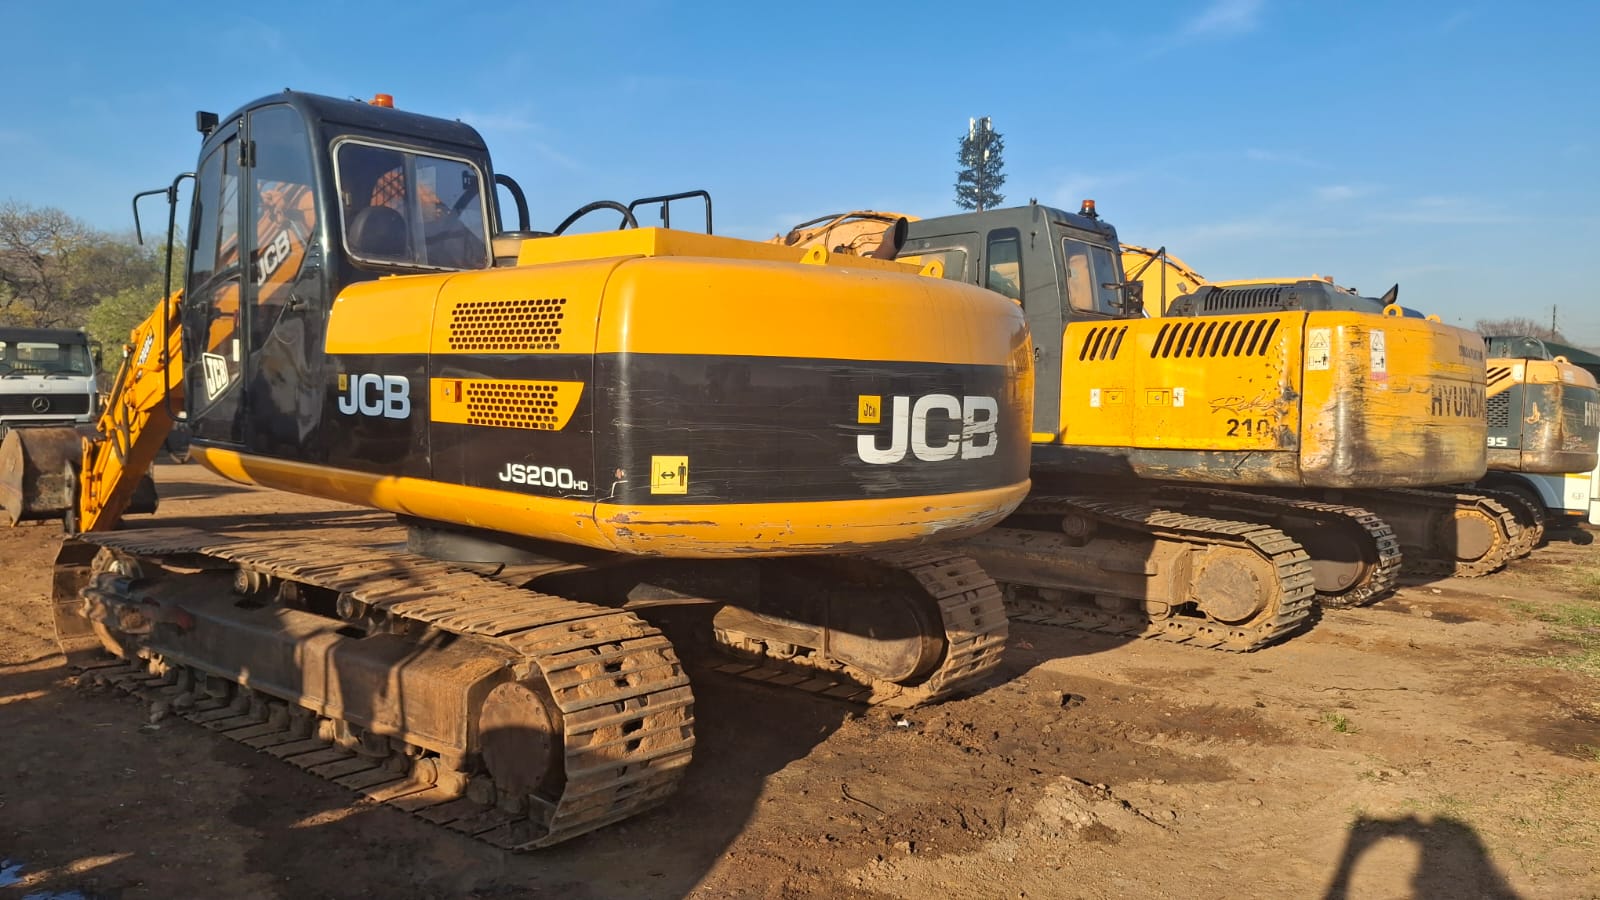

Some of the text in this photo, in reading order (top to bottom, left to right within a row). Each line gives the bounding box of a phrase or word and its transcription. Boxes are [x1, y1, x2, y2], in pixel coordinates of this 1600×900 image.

[257, 229, 291, 287] JCB
[338, 373, 411, 419] JCB
[857, 393, 999, 465] JCB
